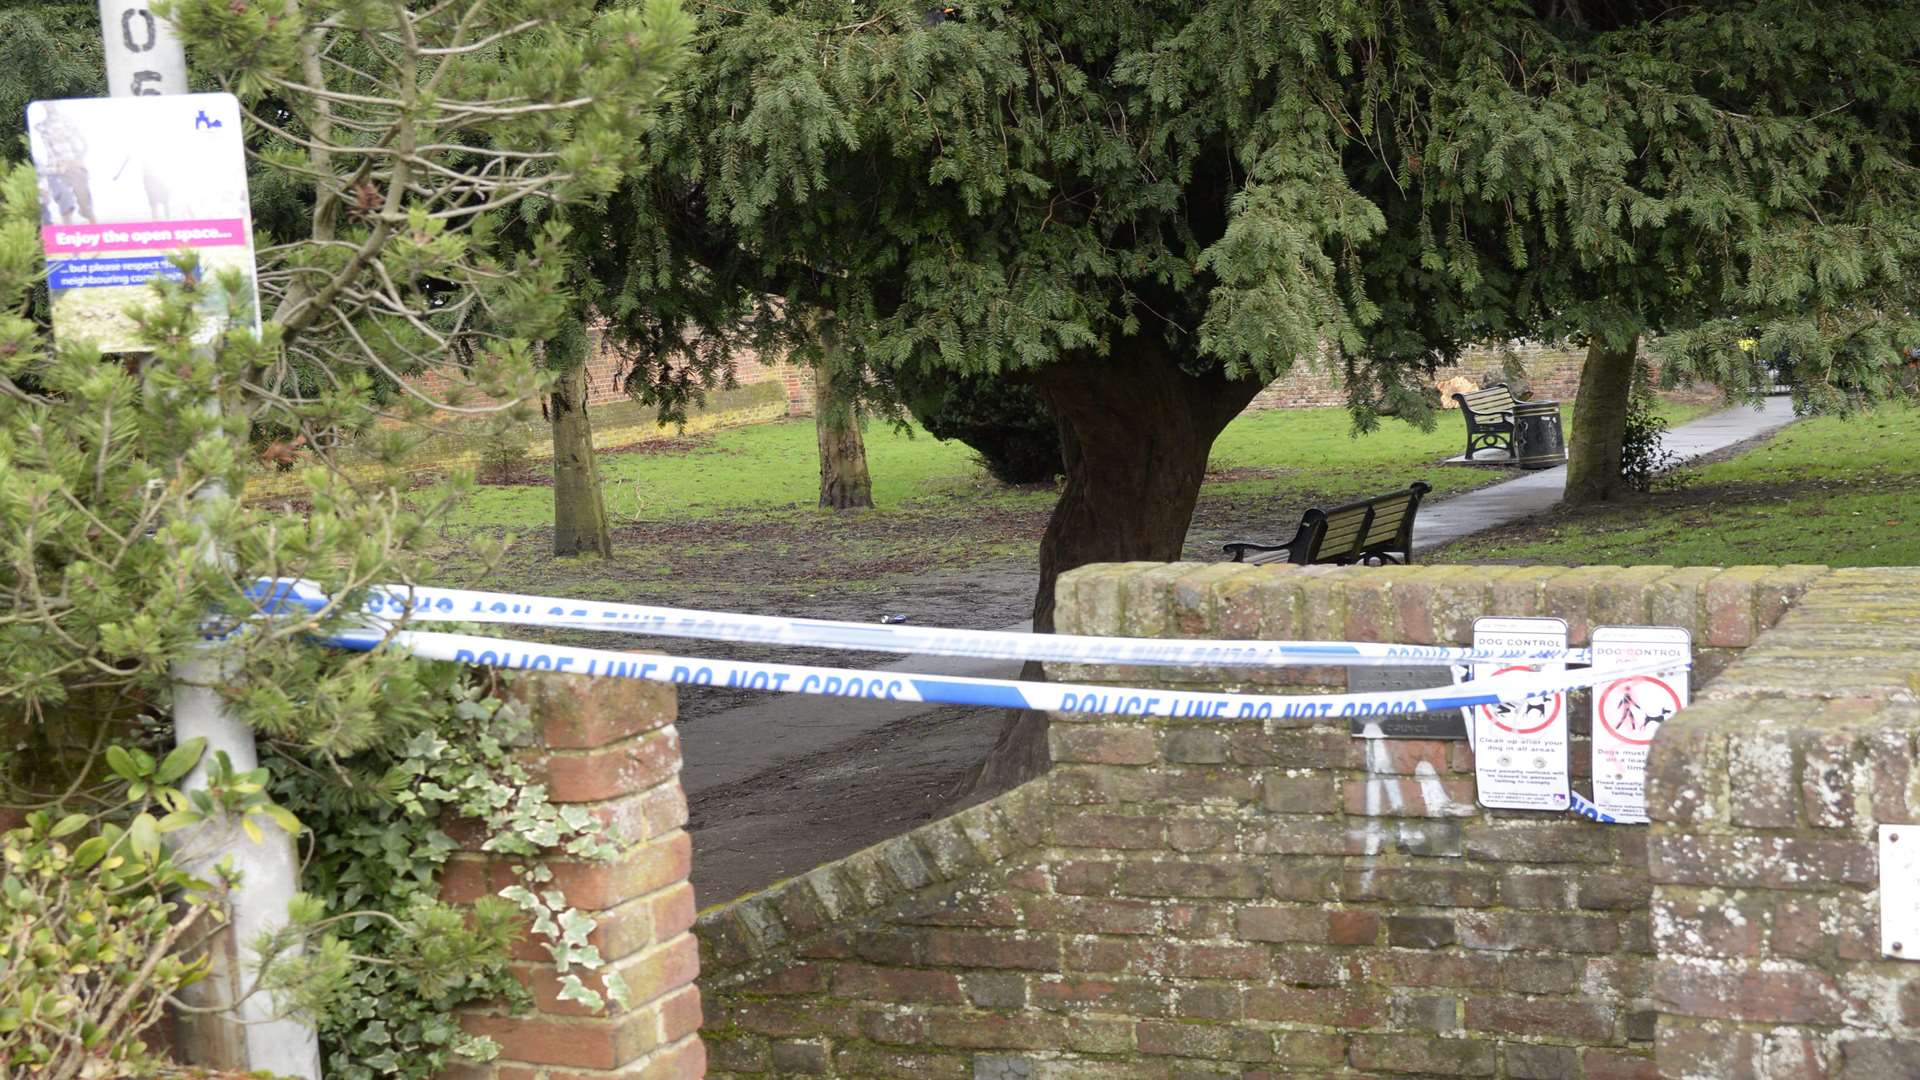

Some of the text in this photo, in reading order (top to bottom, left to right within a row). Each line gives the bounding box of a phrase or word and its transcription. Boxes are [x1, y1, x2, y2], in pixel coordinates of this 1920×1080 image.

[55, 231, 100, 247] Enjoy
[102, 230, 129, 243] the
[131, 229, 172, 244] open
[68, 265, 87, 273] but
[89, 263, 121, 274] please
[123, 261, 159, 274] respect
[61, 274, 129, 287] neighbouring
[1478, 638, 1561, 648] DOG CONTROL
[1597, 647, 1622, 656] DOG
